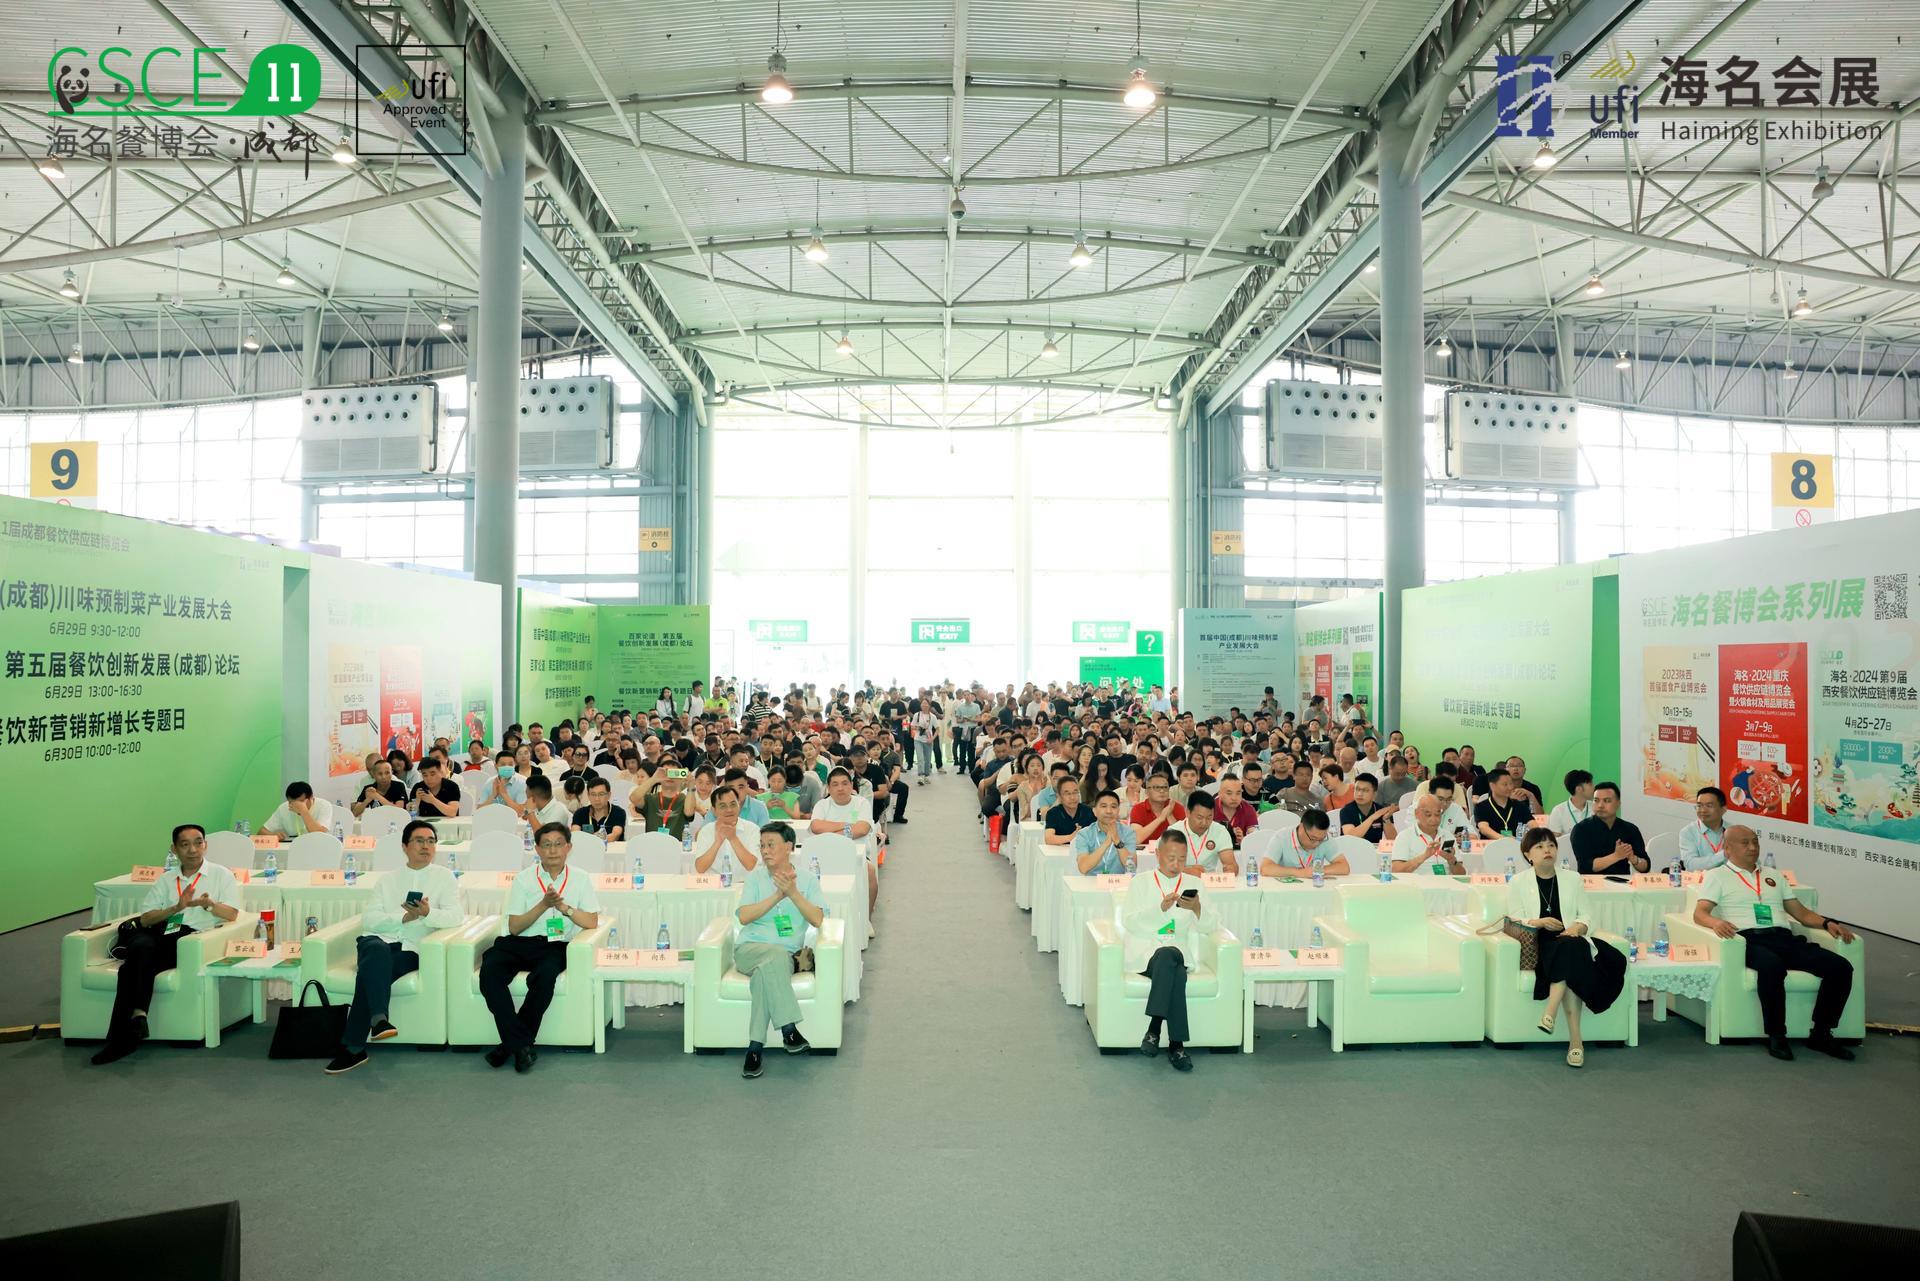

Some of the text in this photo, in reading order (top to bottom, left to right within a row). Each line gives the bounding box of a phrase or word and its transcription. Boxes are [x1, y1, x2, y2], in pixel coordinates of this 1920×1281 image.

[50, 448, 80, 491] 9
[1790, 459, 1817, 500] 8
[1670, 577, 1866, 628] 海名餐博会系列展
[5, 650, 241, 679] 第五届餐饮创新发展(成都)论坛
[1821, 685, 1919, 701] 西安餐饮供应链博览会
[0, 707, 186, 746] 饮新营销新增长专题日
[1844, 716, 1893, 732] 4月25-27日
